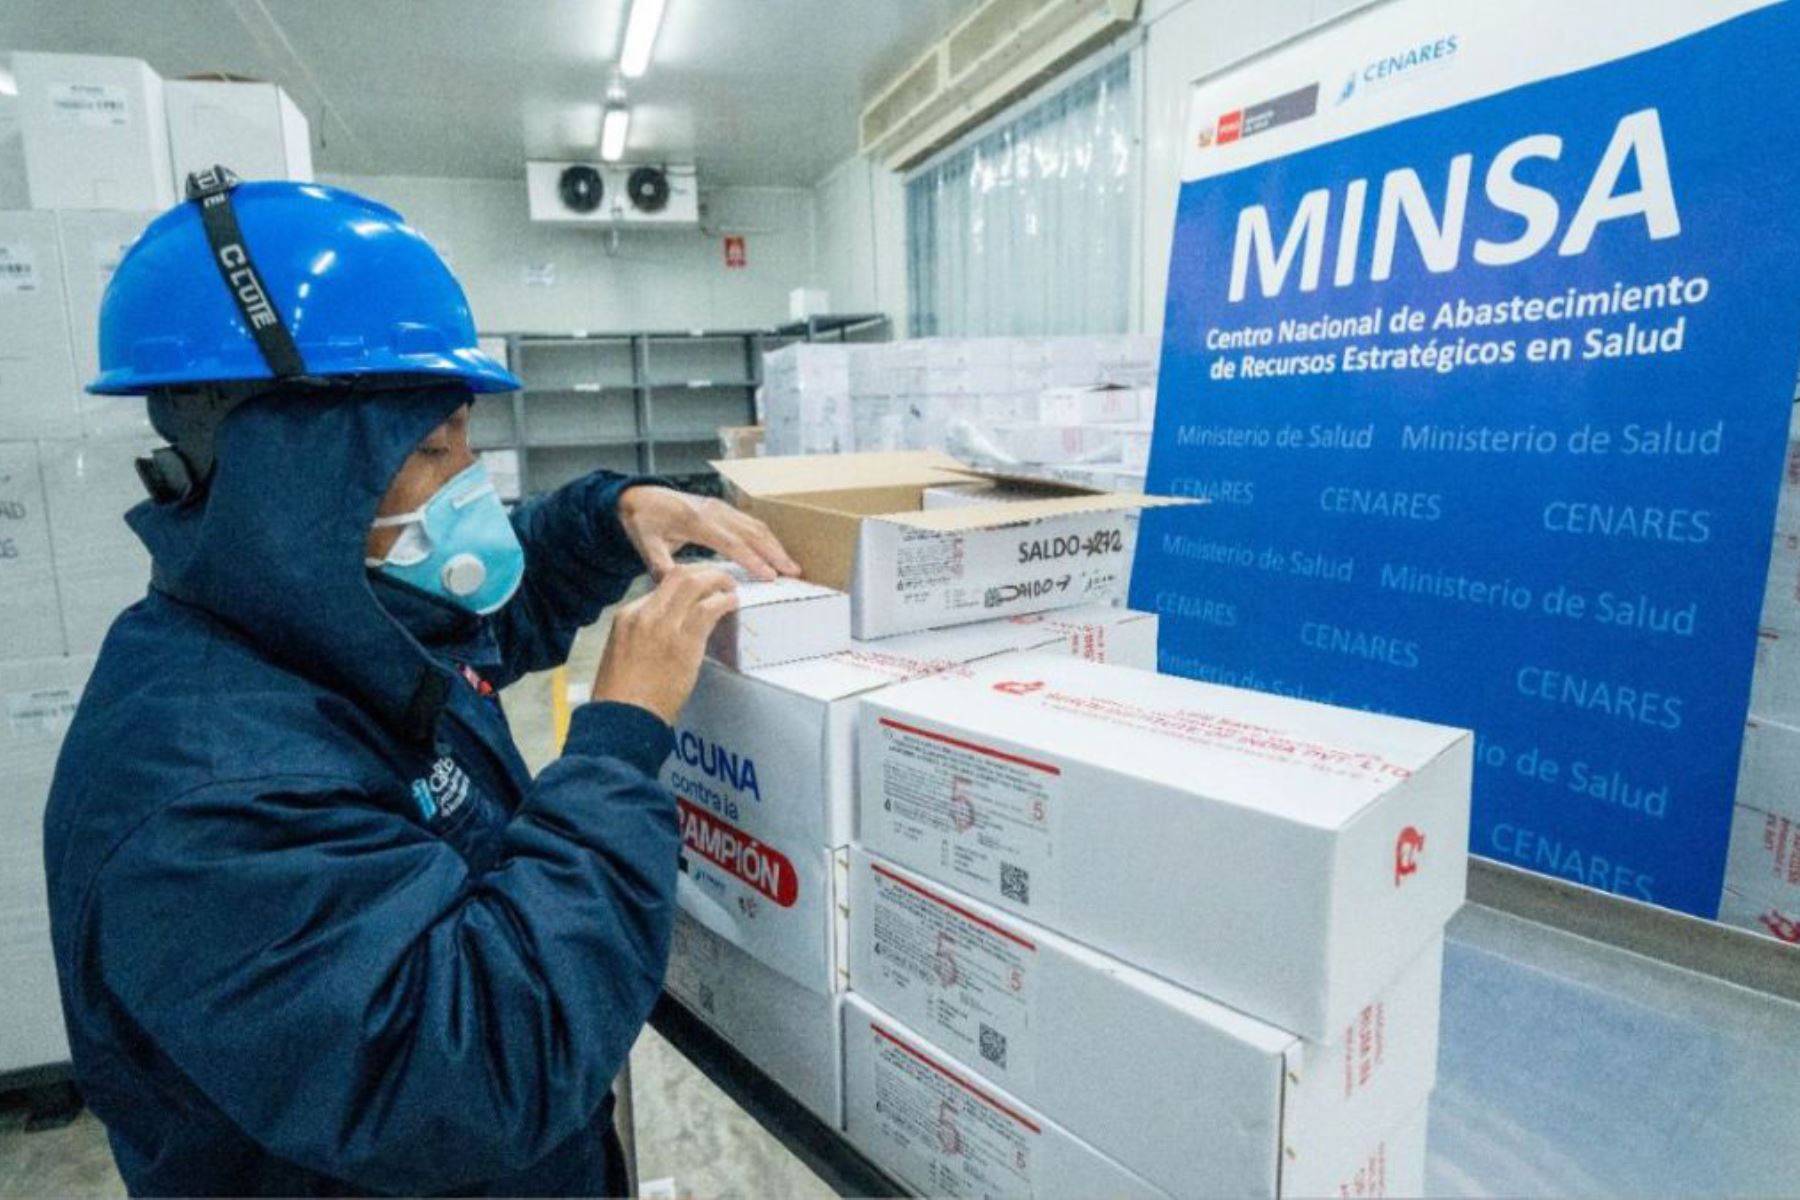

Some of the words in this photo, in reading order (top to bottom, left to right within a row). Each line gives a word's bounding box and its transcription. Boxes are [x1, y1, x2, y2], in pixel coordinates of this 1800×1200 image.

[1362, 35, 1459, 83] CENARES
[1228, 107, 1681, 302] MINSA
[220, 243, 278, 330] CLUTE
[1206, 327, 1273, 350] Centro
[1278, 307, 1383, 344] Nacional
[1389, 304, 1426, 333] de
[1432, 275, 1709, 331] Abastecimiento
[1210, 356, 1236, 381] de
[1241, 352, 1336, 379] Recursos
[1342, 337, 1517, 374] Estratégicos
[1526, 337, 1573, 362] en
[1582, 316, 1686, 360] Salud
[1177, 424, 1270, 448] Ministerio
[1276, 425, 1304, 449] de
[1308, 423, 1374, 450] Salud
[1401, 424, 1557, 453] Ministerio
[1567, 422, 1611, 454] de
[1622, 420, 1724, 455] Salud
[1320, 486, 1442, 521] CENARES
[1543, 500, 1711, 543] CENARES
[1018, 534, 1080, 563] SALDO
[1162, 533, 1254, 567] Ministerio
[1259, 547, 1284, 572] de
[1290, 551, 1354, 582] Salud
[1156, 591, 1237, 627] CENARES
[1380, 562, 1532, 611] Ministerio
[1542, 585, 1585, 620] de
[1595, 591, 1697, 636] Salud
[1301, 621, 1420, 669] CENARES
[1516, 666, 1683, 730] CENARES
[671, 771, 721, 811] contra
[723, 796, 739, 821] la
[1515, 748, 1560, 782] de
[1568, 759, 1669, 819] Salud
[1032, 799, 1045, 822] 5
[1010, 969, 1022, 992] 5
